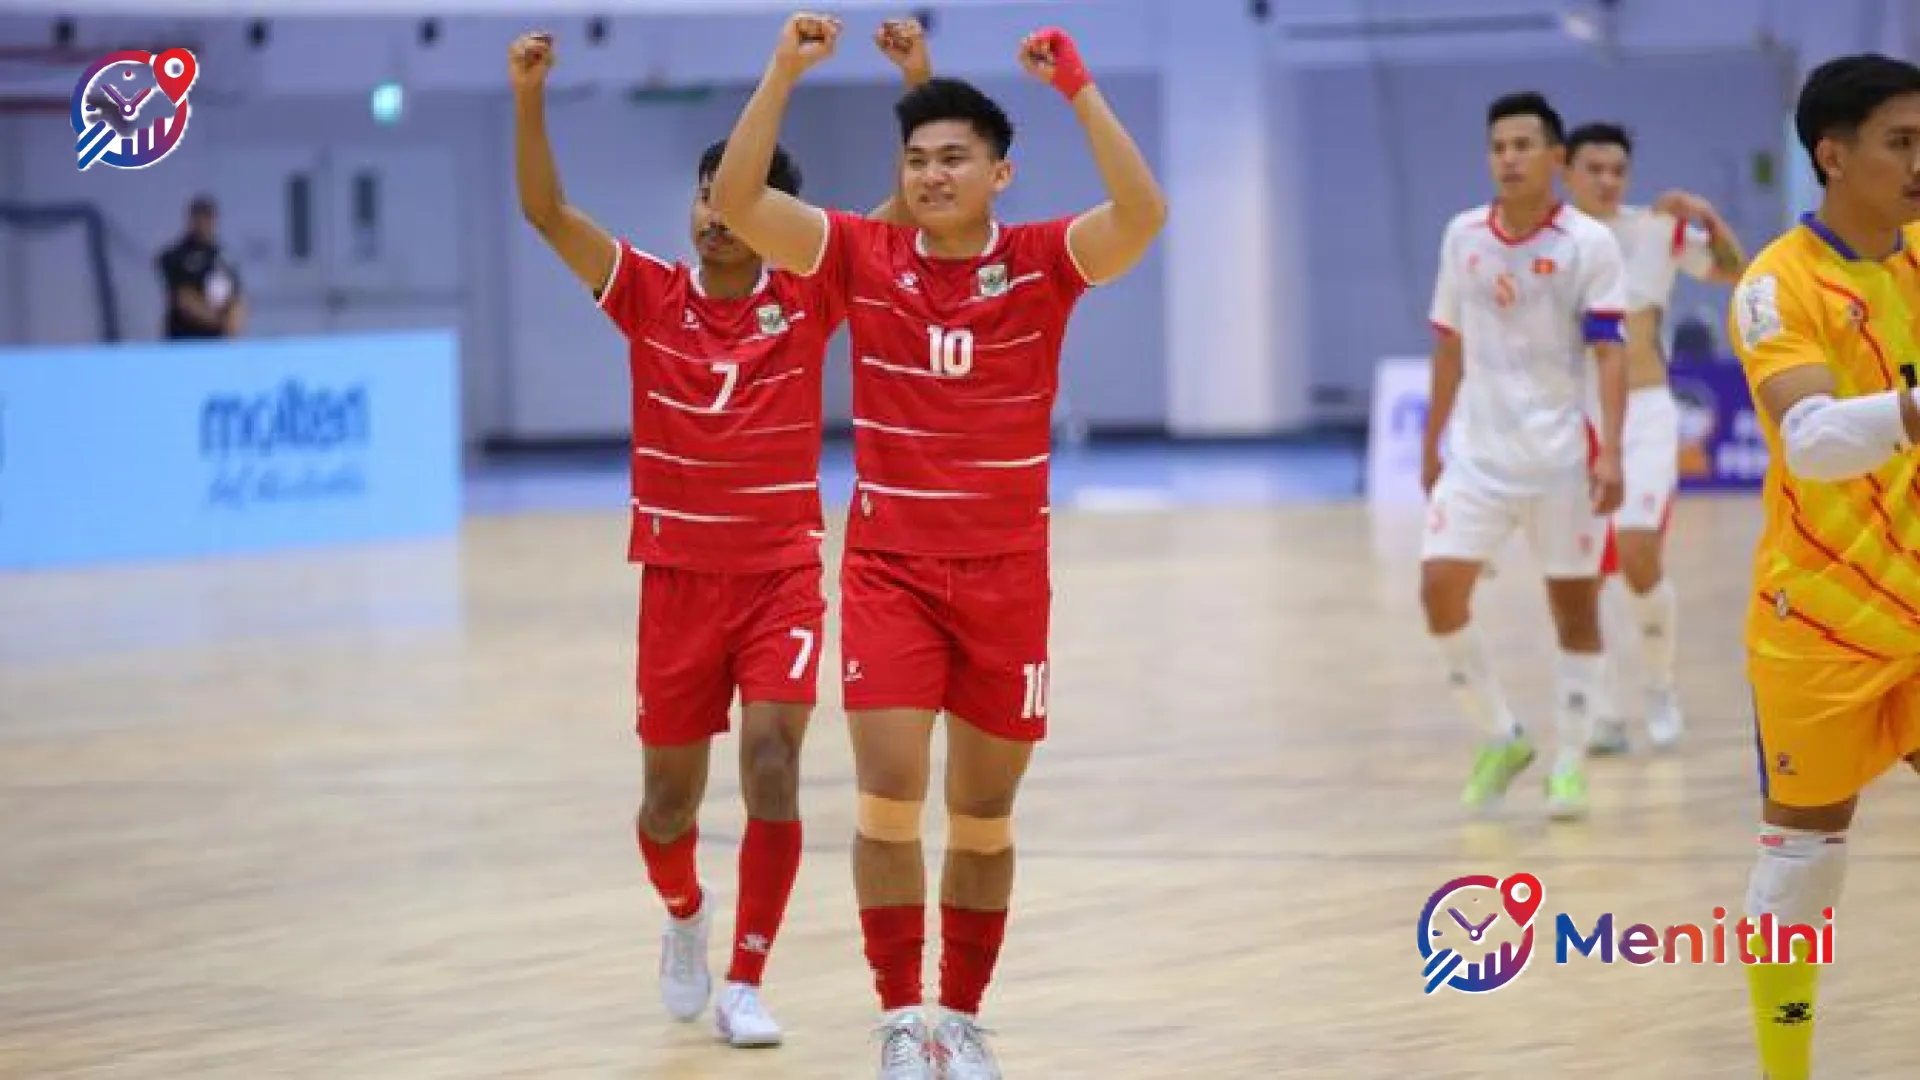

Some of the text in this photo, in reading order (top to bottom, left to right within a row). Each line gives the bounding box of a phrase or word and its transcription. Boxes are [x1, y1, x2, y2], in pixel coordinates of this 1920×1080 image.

[927, 324, 974, 377] 10
[709, 362, 739, 412] 7
[788, 628, 814, 679] 7
